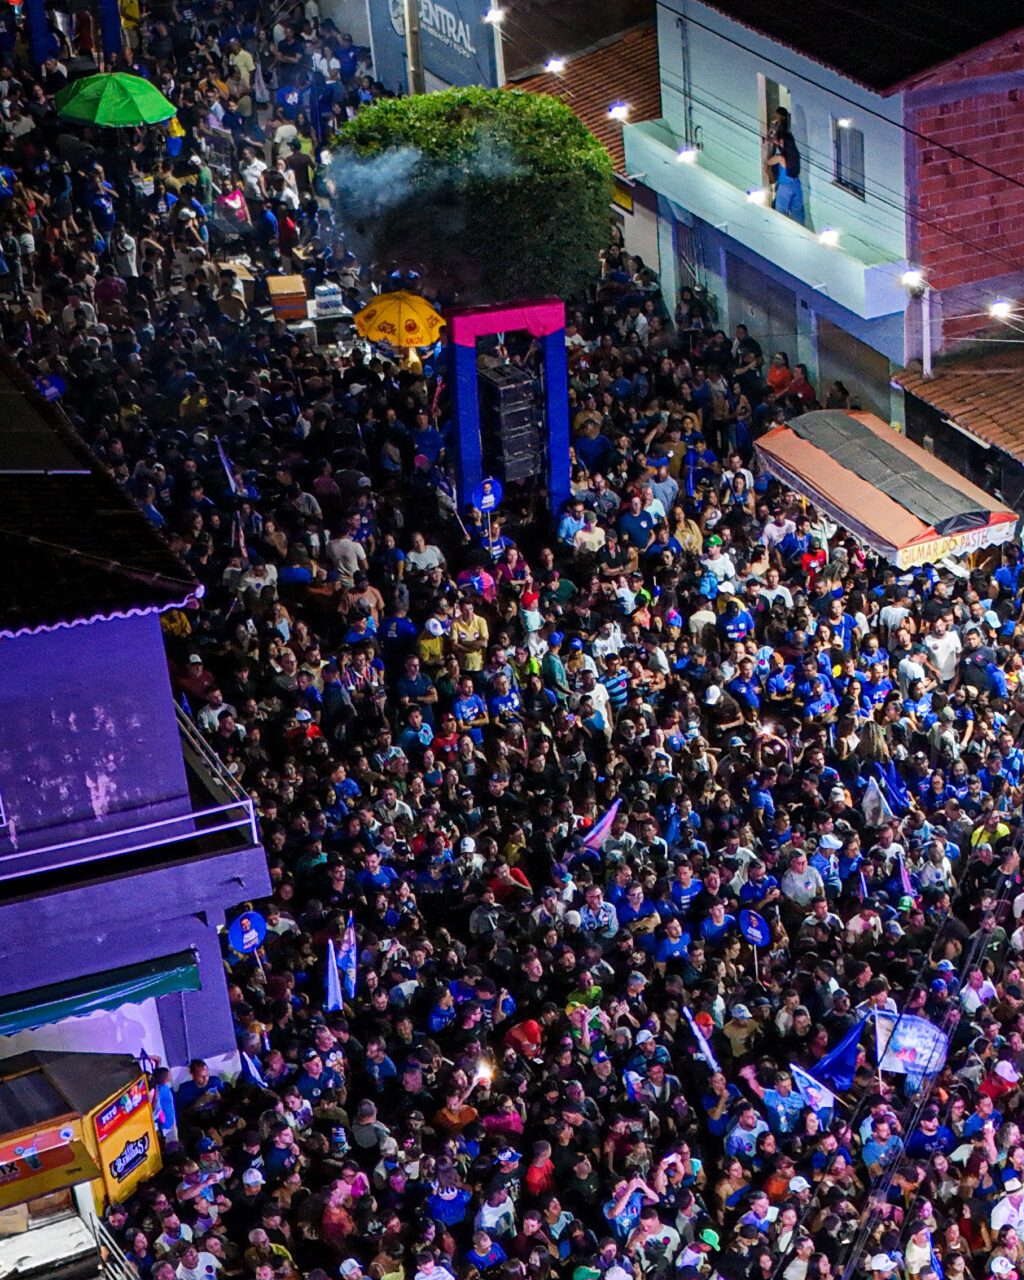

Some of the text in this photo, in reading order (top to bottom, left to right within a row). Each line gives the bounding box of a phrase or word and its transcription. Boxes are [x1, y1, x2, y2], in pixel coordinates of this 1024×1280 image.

[419, 0, 476, 53] ENTRAL
[901, 528, 989, 566] GILMAR DO PASTEL
